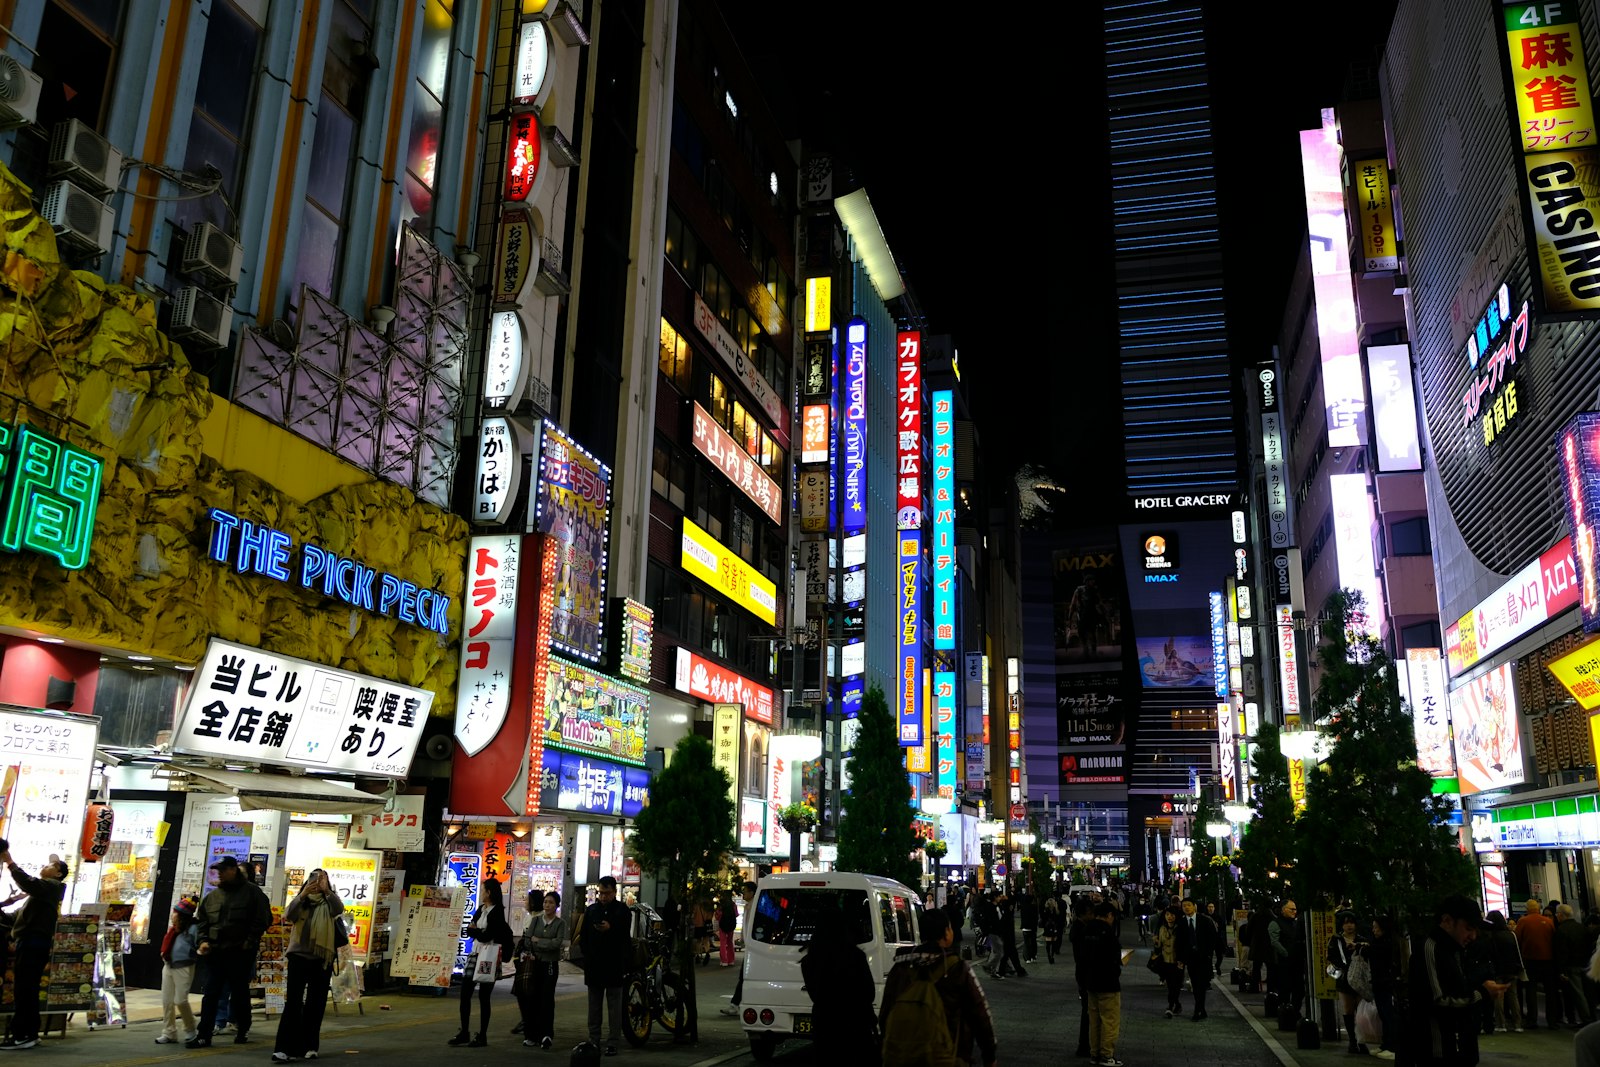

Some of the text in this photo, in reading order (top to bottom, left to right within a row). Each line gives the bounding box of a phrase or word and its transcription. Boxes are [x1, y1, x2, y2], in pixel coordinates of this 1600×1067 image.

[1519, 3, 1563, 26] 4F
[1521, 32, 1581, 114] 麻雀
[1525, 117, 1575, 134] スリー
[1525, 127, 1593, 149] ファイブ
[1362, 165, 1380, 211] 生ビール
[503, 225, 522, 293] お好み焼き
[699, 306, 713, 337] 3F
[809, 343, 824, 387] 山内農場
[1463, 300, 1529, 428] スリーファイブ
[489, 397, 505, 408] 1F
[1259, 369, 1275, 407] Booth
[484, 425, 505, 436] 新宿
[694, 413, 707, 443] 5F
[899, 337, 919, 499] カラオケ歌広場
[1483, 379, 1518, 447] 新宿店
[545, 438, 569, 464] 出会い
[1266, 417, 1278, 461] ネットカフェ
[479, 437, 504, 495] かっぱ
[545, 458, 568, 484] カフェ
[569, 459, 607, 510] キラリ
[707, 425, 771, 512] 山内農場
[847, 431, 859, 500] SHINJUKU
[0, 422, 104, 571] 間
[479, 502, 497, 513] B1
[1135, 494, 1231, 509] HOTEL GRACERY
[1271, 474, 1281, 505] カプセル
[807, 518, 820, 528] 3F
[936, 399, 952, 639] カラオケ&パーティー館
[806, 543, 821, 583] お好み焼
[903, 540, 918, 555] 薬
[209, 507, 450, 635] THE PICK PECK
[499, 538, 516, 609] 大衆酒場
[720, 556, 747, 600] 鳥貴族
[1144, 574, 1178, 583] IMAX
[1274, 554, 1290, 595] Booth
[464, 548, 499, 670] トラノコ
[901, 561, 918, 645] マツモトキヨシ
[1507, 580, 1539, 627] 鳥メロ
[1281, 615, 1293, 651] カラオケ
[209, 653, 302, 704] 当ビル
[1214, 627, 1227, 693] カラオケランド
[352, 686, 422, 729] 喫煙室
[462, 680, 487, 735] やきとん
[480, 669, 504, 723] やきとり
[711, 672, 757, 712] 焼肉屋さかい
[904, 656, 915, 715] Tax Free Shop
[1284, 660, 1298, 713] まねきねこ
[193, 699, 294, 748] 全店舗
[1422, 695, 1438, 726] 九十九
[2, 735, 71, 755] フロアご案内
[937, 683, 952, 799] カラオケ館
[1080, 756, 1123, 769] MARUHAN
[1220, 716, 1235, 779] マルハン
[577, 760, 611, 810] 龍馬
[26, 811, 65, 825] ヤキトリ
[91, 808, 115, 857] お食事処
[371, 813, 418, 827] トラノコ
[1507, 824, 1535, 841] FamilyMart
[484, 839, 500, 878] 立呑み
[411, 888, 422, 896] B2
[416, 954, 441, 963] トラノコ
